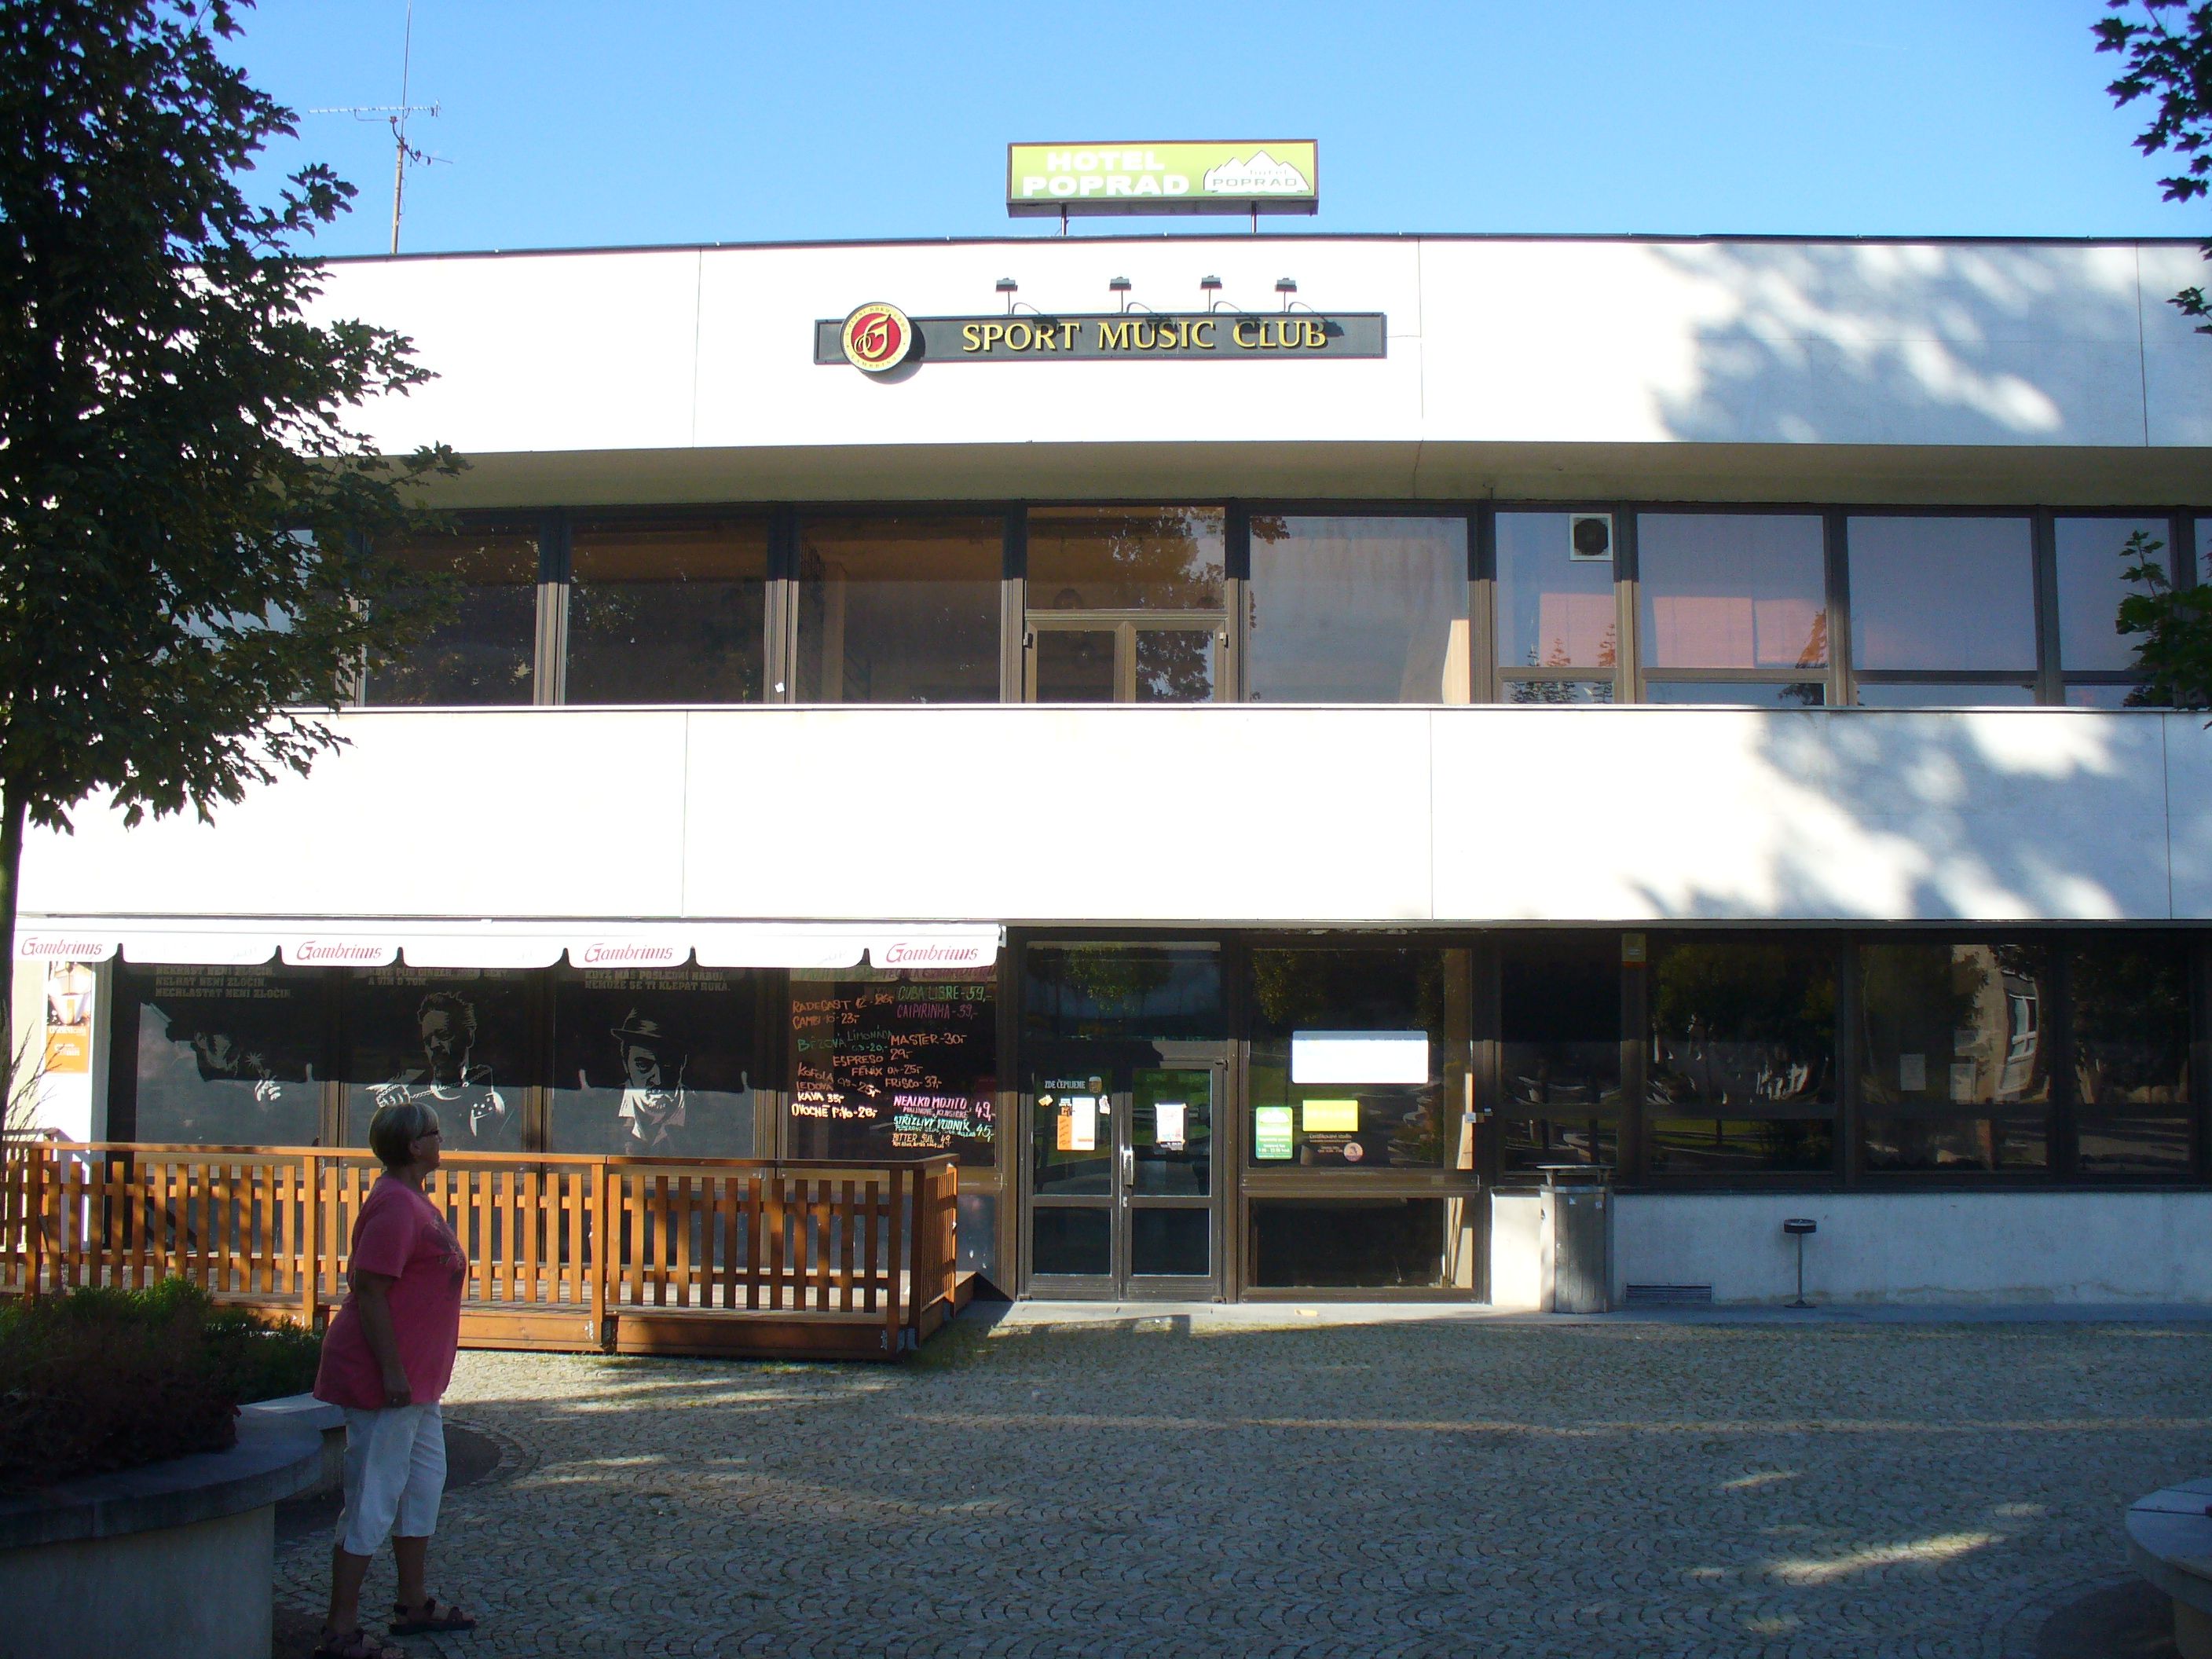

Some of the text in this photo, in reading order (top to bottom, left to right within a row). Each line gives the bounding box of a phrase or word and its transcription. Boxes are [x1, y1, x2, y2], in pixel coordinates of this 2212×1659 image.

[1047, 151, 1166, 171] HOTEL
[1023, 174, 1189, 196] POPRAD
[1213, 178, 1297, 187] POPRAD
[962, 320, 1327, 351] SPORT MUSIC CLUB
[21, 937, 103, 956] Gambrinus
[297, 940, 382, 960] Gambrinus
[584, 943, 673, 963] Gambrinus
[886, 943, 979, 963] Gambrinus
[898, 985, 925, 1001] CUBA
[793, 998, 851, 1013] RADEGAST
[896, 1002, 950, 1020] CAIPIRINHA
[891, 1033, 939, 1046] MASTER
[833, 1054, 884, 1068] ESPRESO
[1045, 1080, 1056, 1089] ZDE
[893, 1095, 930, 1107] NEALKO
[932, 1097, 967, 1109] MOJITO
